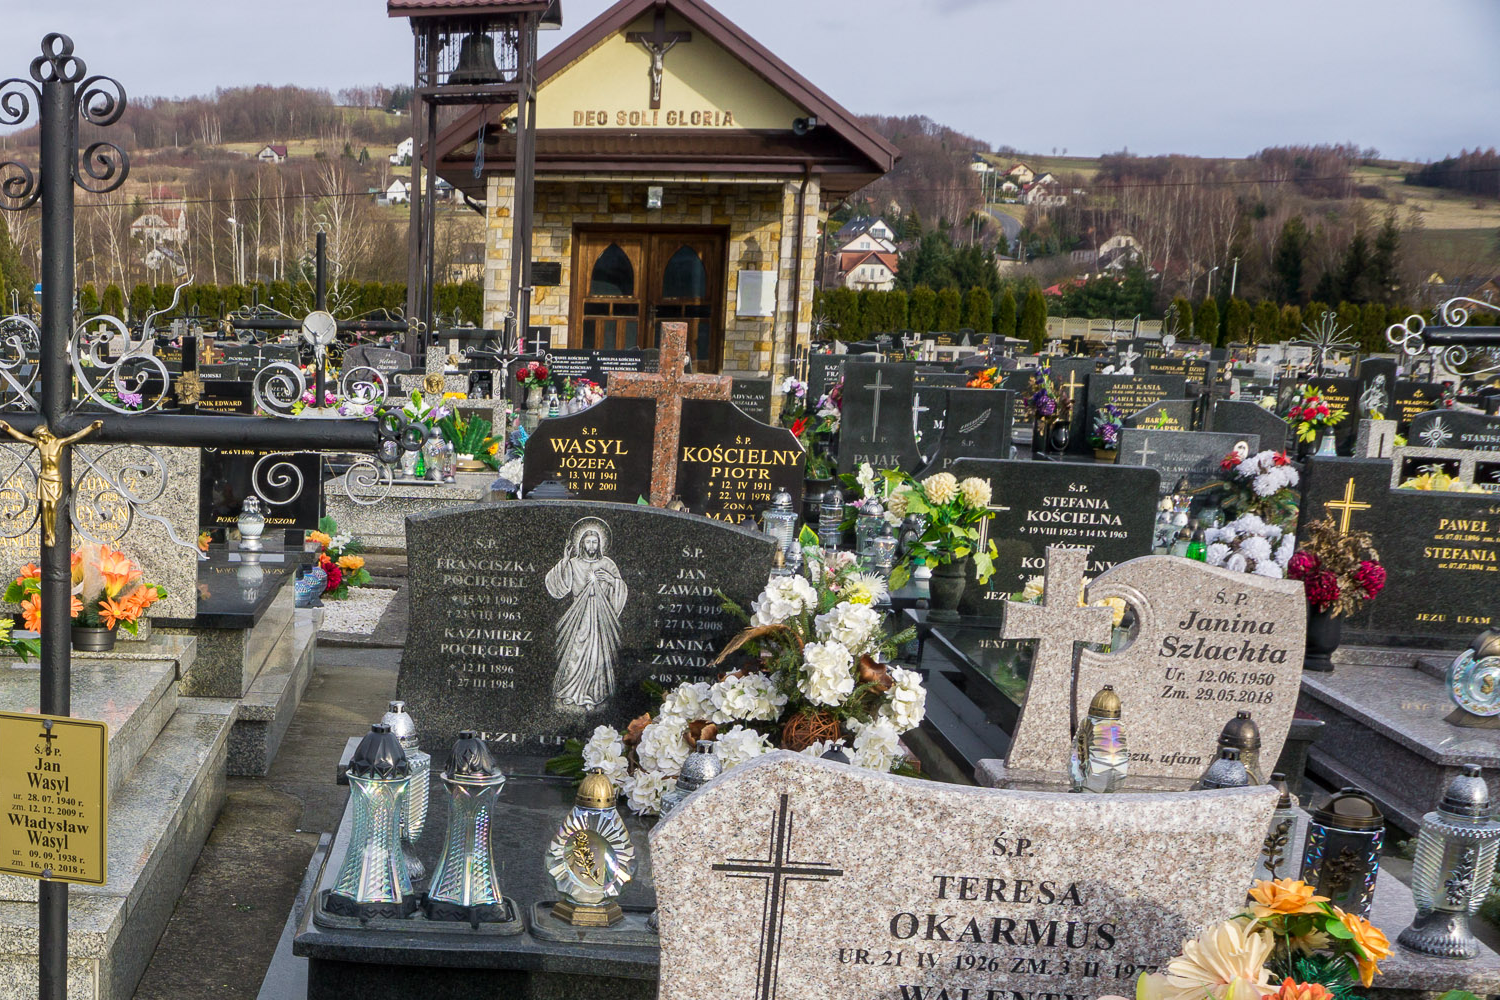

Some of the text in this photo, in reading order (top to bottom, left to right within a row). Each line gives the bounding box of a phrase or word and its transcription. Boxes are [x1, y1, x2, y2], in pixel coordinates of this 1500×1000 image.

[573, 110, 734, 126] DEO SOLI GLORIA
[550, 438, 628, 455] WASYL
[559, 455, 615, 469] JÓZEFA
[682, 444, 802, 466] KOŚCIELNY
[569, 471, 617, 480] 13. VII 1941
[711, 467, 771, 479] PIOTR
[584, 482, 594, 490] IV
[599, 482, 617, 491] 2001
[721, 481, 772, 491] 12. IV 1911
[719, 491, 771, 501] 22. VI 1978
[1043, 496, 1110, 510] STEFANIA
[723, 502, 753, 511] ŻONA
[1026, 508, 1123, 526] KOŚCIELNA
[1439, 518, 1490, 532] PAWEŁ
[1028, 527, 1038, 535] 19
[1040, 527, 1057, 536] VIII
[1059, 528, 1077, 537] 1923
[1109, 531, 1128, 539] 1963
[682, 545, 705, 558] Ś.P.
[1423, 546, 1497, 561] STEFANIA
[436, 558, 535, 573] FRANCISZKA
[443, 573, 528, 590] POCIĘGIEL
[676, 569, 707, 580] JAN
[463, 595, 478, 605] 15
[495, 596, 518, 605] 1902
[455, 610, 470, 620] 23
[496, 611, 521, 621] 1963
[669, 604, 722, 615] 27 V 1919
[664, 619, 723, 630] 27 IX 2008
[1178, 610, 1275, 635] Janina
[1415, 613, 1492, 625] JEZU UFAM
[444, 628, 533, 642] KAZIMIERZ
[440, 643, 524, 658] POCIĘGIEL
[656, 638, 714, 652] JANINA
[1158, 635, 1288, 664] Szlachta
[462, 664, 514, 674] 12 II 1896
[457, 678, 515, 688] 27 III 1984
[1164, 667, 1276, 686] Ur. 12.06.1950
[1161, 685, 1274, 704] Zm. 29.05.2018
[34, 757, 61, 773] Jan
[1160, 752, 1202, 766] ufam
[27, 772, 69, 796] Wasyl
[57, 797, 76, 807] 1940
[12, 803, 77, 817] zm. 2009
[8, 812, 89, 835] Władysław
[27, 829, 69, 853] Wasyl
[991, 832, 1035, 857] Ś.P.
[12, 849, 77, 864] ur. 1938
[11, 859, 78, 874] zm. 2018
[933, 875, 1084, 907] TERESA
[889, 911, 1117, 951] OKARMUS
[838, 947, 875, 966] UR.
[883, 950, 903, 967] 21
[917, 952, 943, 969] IV
[955, 954, 999, 972] 1926
[1010, 957, 1052, 976] ZM.
[1059, 959, 1070, 976] 3
[1083, 961, 1100, 978] II
